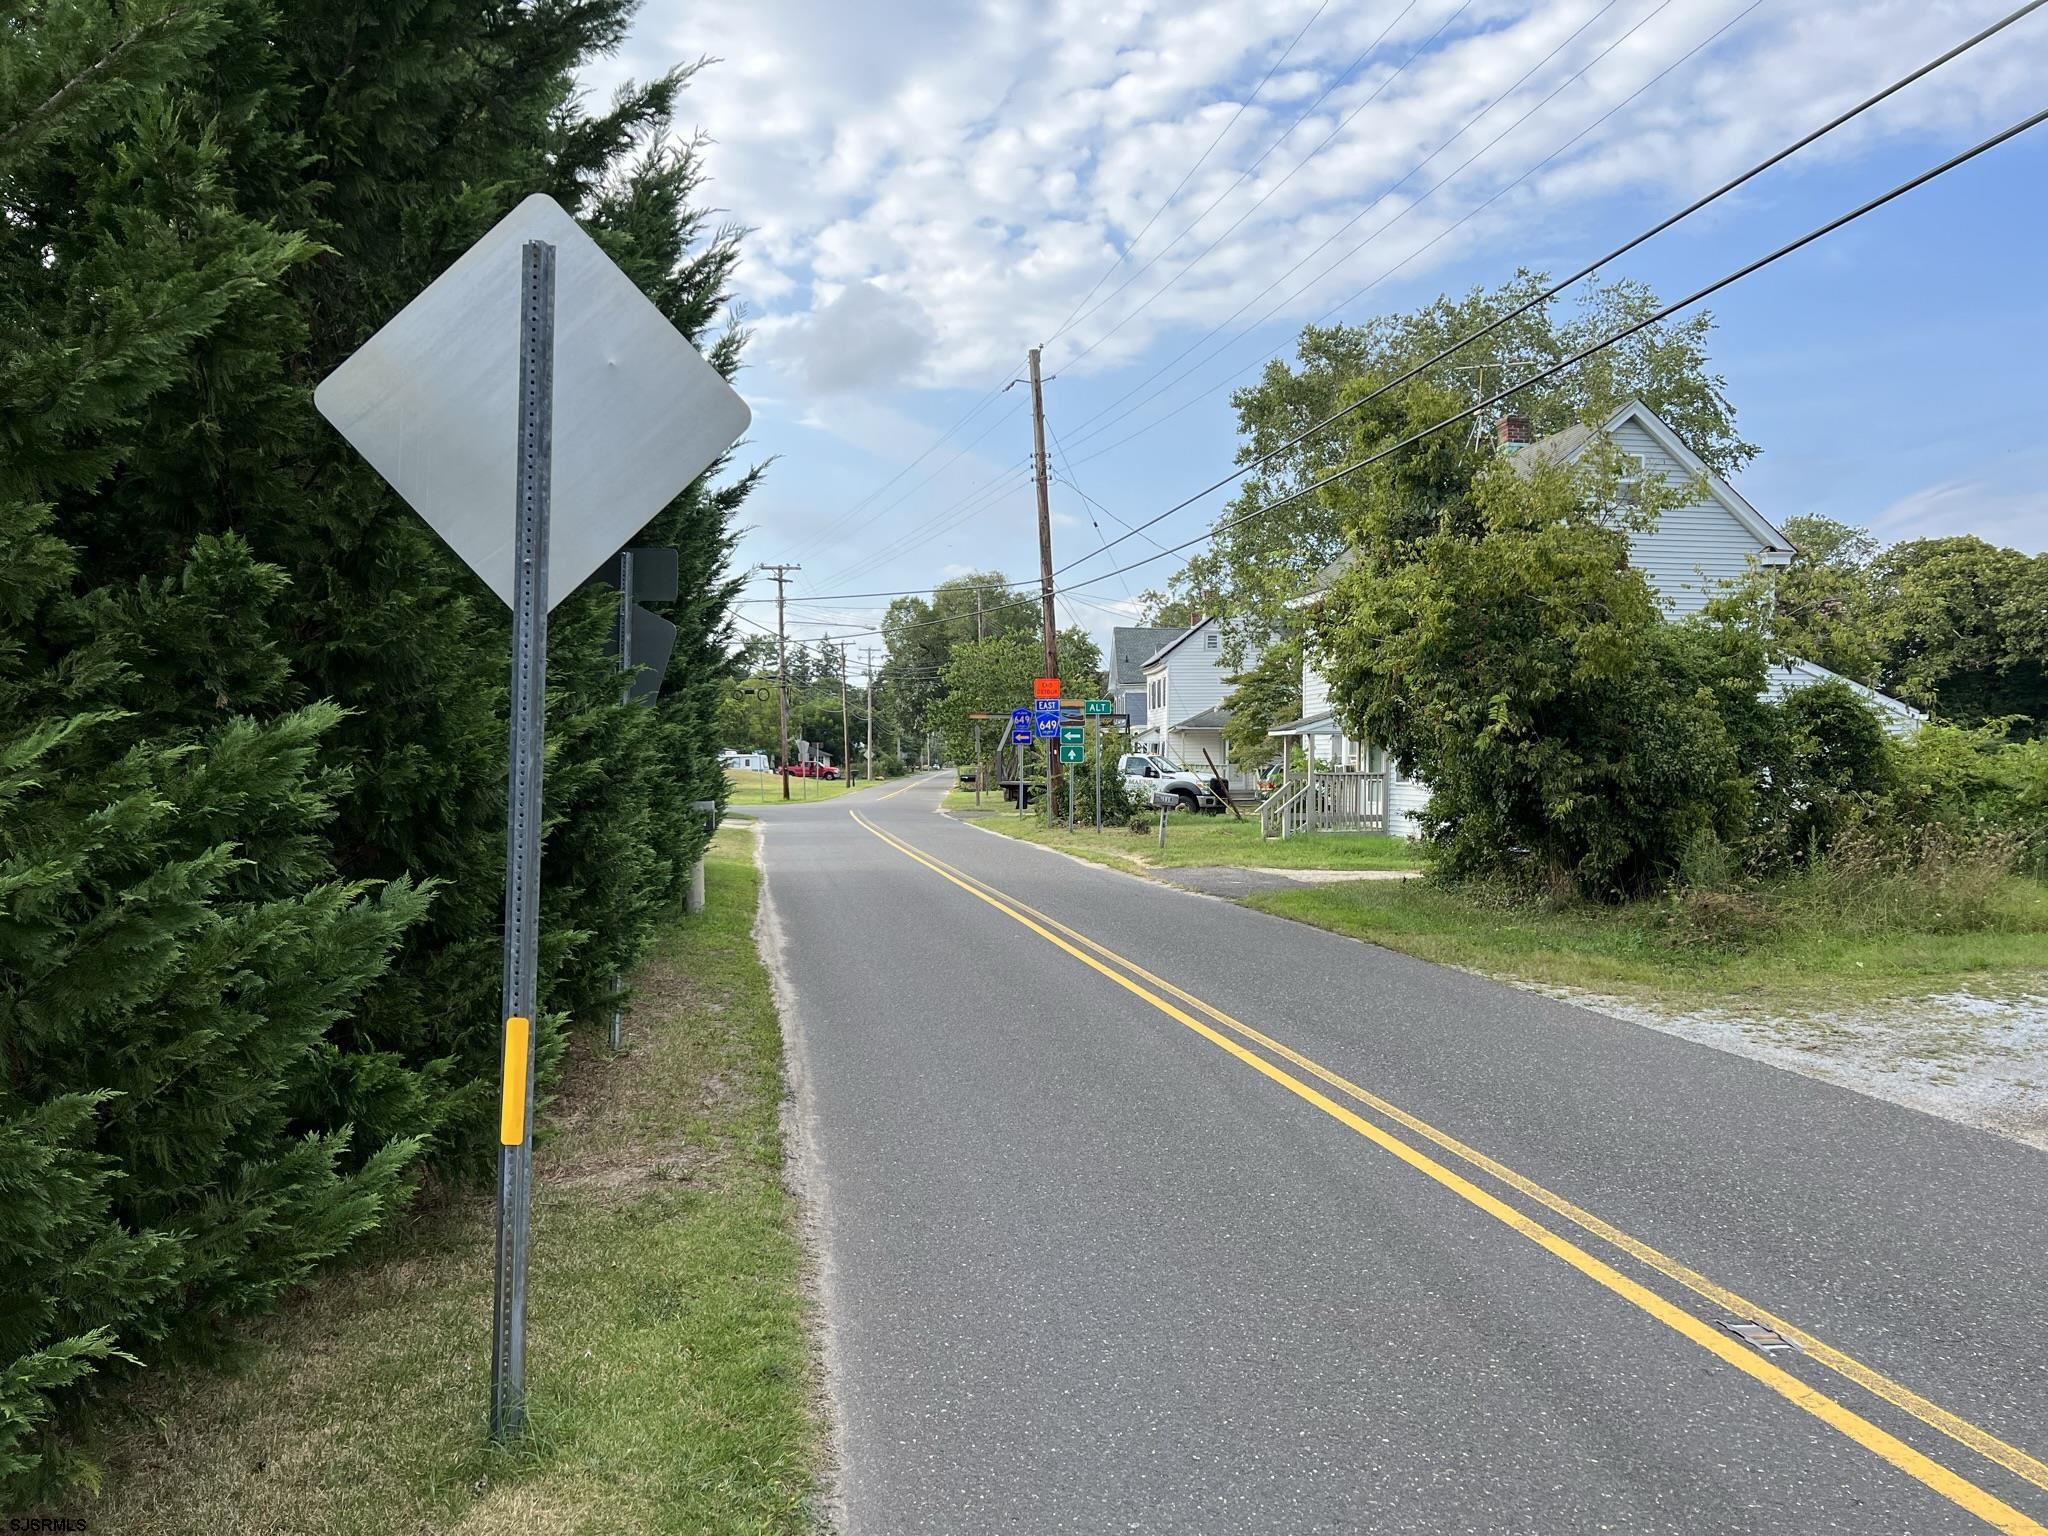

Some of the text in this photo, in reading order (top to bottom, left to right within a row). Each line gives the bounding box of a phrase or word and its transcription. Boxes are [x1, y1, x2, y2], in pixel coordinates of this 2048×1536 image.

[1039, 701, 1056, 710] EAST
[1089, 704, 1106, 712] ALT
[1014, 714, 1030, 724] 649
[1040, 720, 1057, 730] 649
